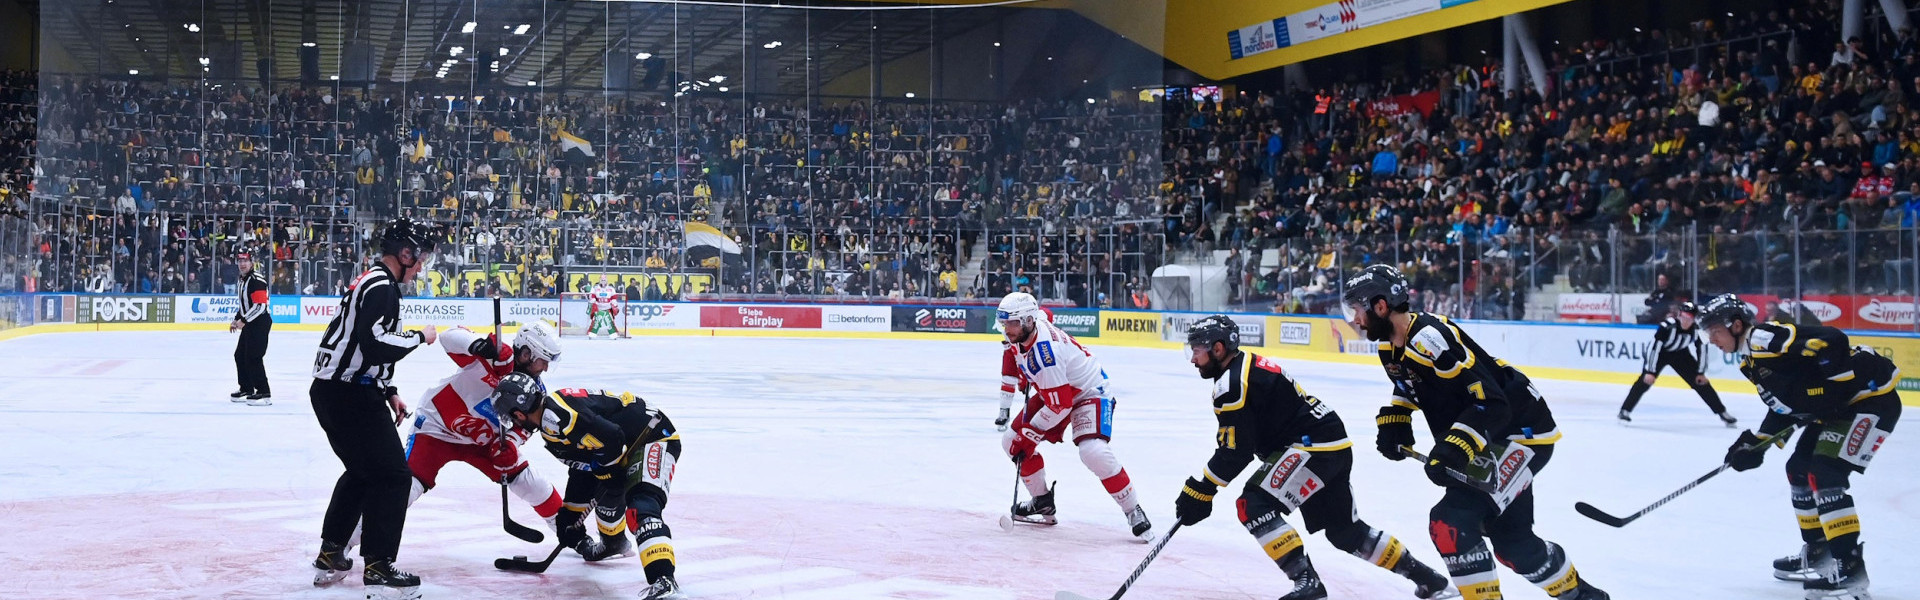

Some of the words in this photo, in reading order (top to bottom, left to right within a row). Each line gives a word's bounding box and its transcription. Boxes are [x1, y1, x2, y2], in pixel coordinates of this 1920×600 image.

[92, 297, 152, 321] FORST
[273, 305, 297, 316] BMI
[935, 308, 966, 319] PROFI
[742, 316, 783, 328] Fairplay
[841, 314, 885, 324] betonform
[935, 319, 966, 328] COLOR
[1106, 318, 1157, 333] MUREXIN
[1281, 325, 1309, 339] SELECTRA
[1467, 381, 1486, 400] 7
[1047, 391, 1061, 405] 11
[1848, 419, 1869, 454] GERAX
[648, 444, 659, 478] GERAX
[1271, 452, 1300, 488] GERAX
